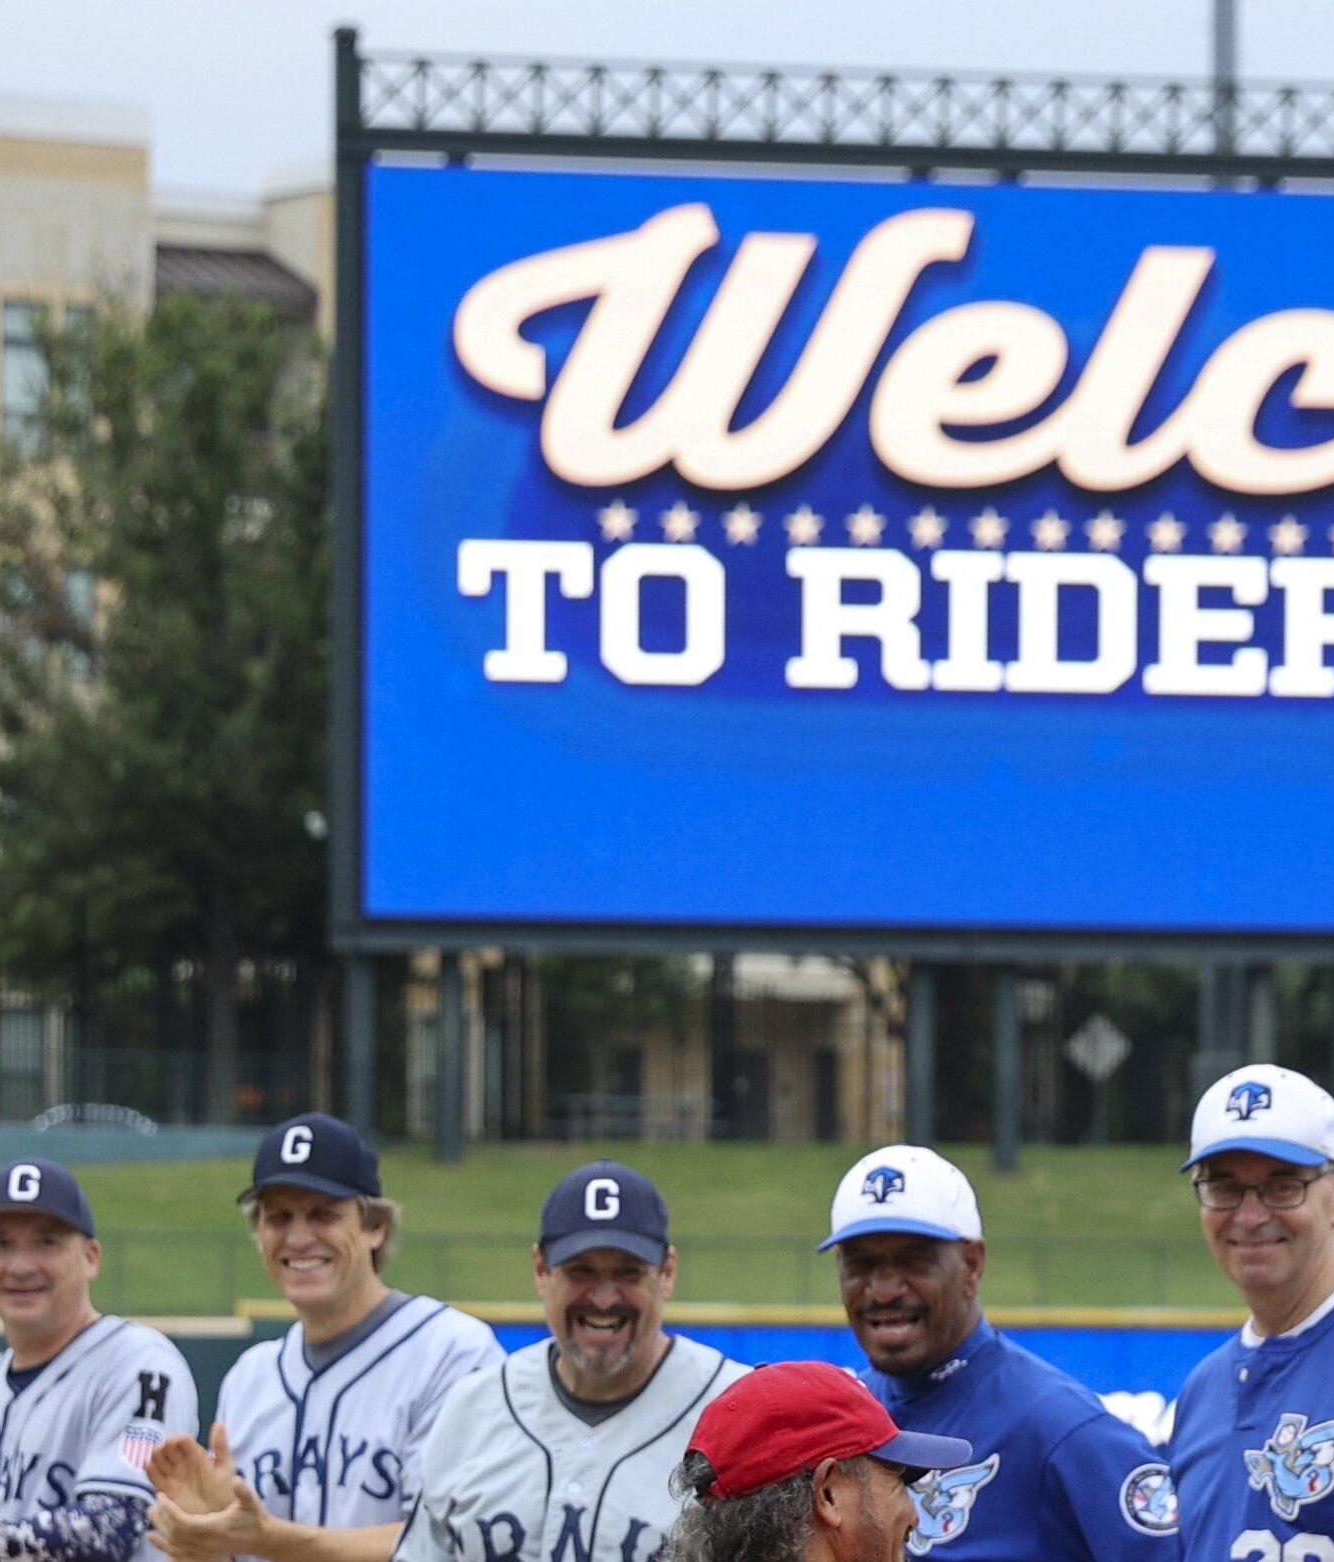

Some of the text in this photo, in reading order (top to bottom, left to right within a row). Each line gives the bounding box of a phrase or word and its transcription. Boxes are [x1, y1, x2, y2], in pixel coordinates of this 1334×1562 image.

[457, 539, 726, 686] TO
[280, 1125, 314, 1164] G
[8, 1164, 42, 1202] G
[585, 1178, 620, 1220] G
[132, 1370, 170, 1422] H
